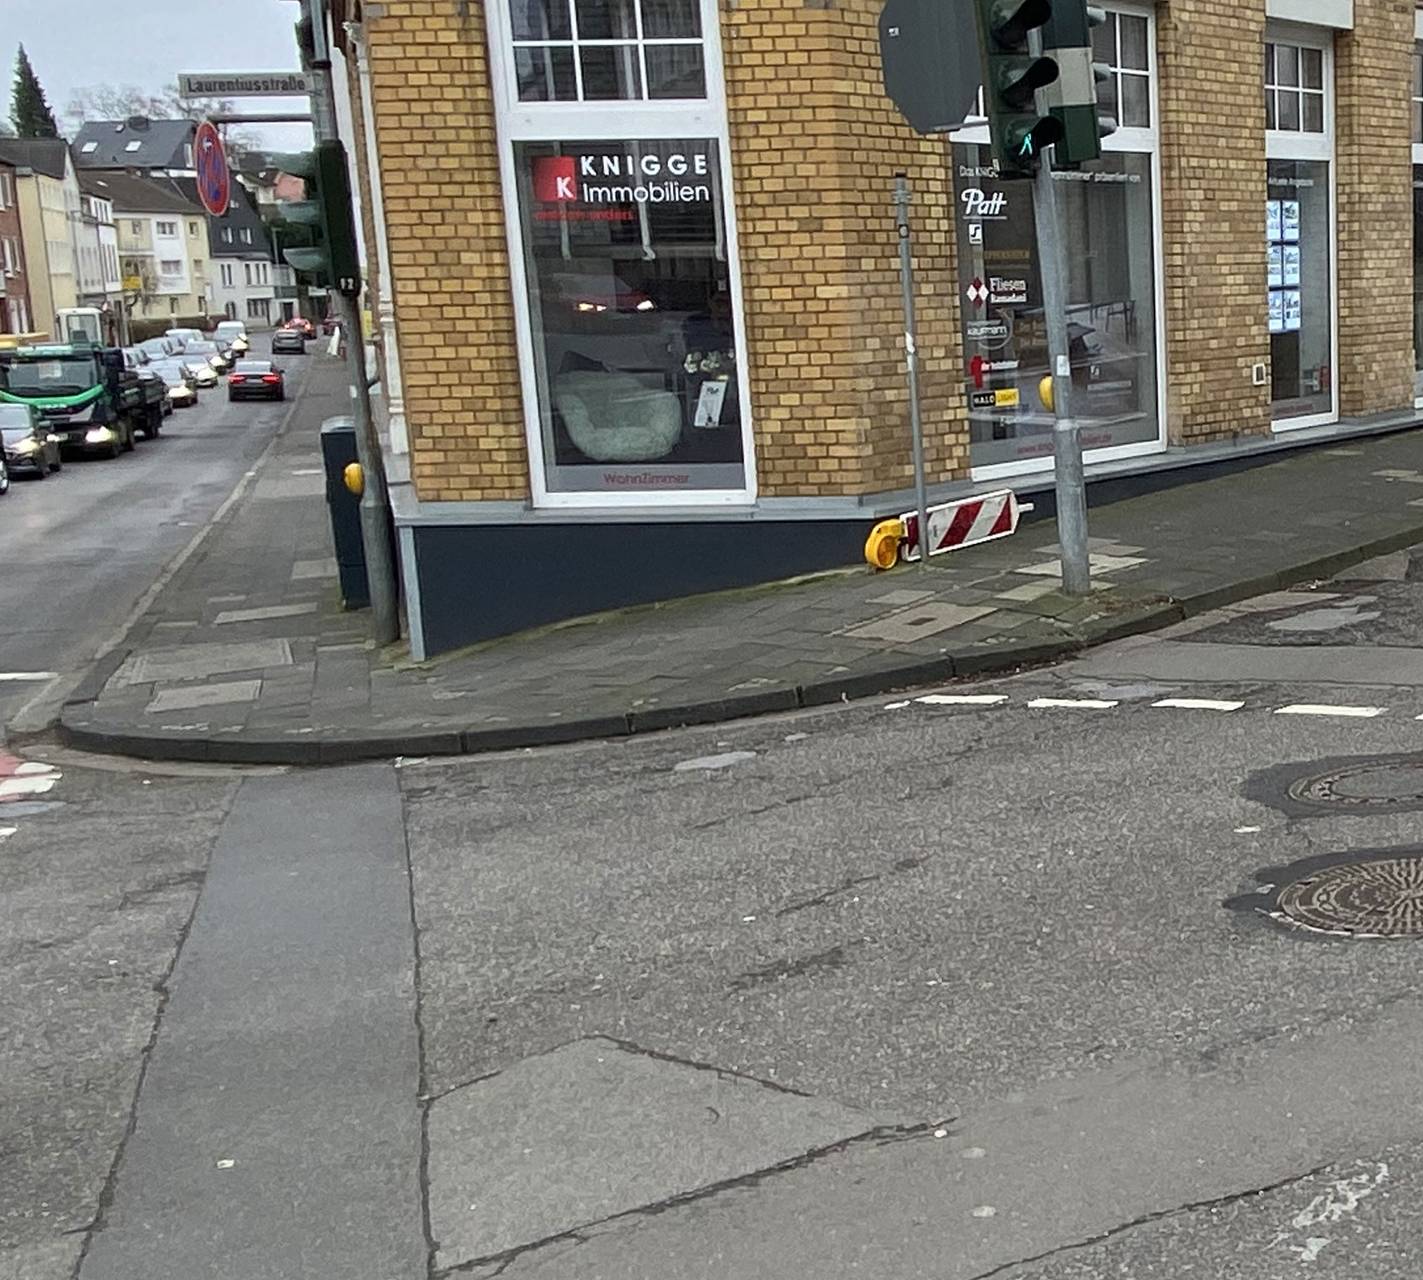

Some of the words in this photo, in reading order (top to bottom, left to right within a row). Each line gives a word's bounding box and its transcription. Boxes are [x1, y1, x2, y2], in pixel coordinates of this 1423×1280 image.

[187, 77, 305, 92] Laurentiusstraße
[580, 155, 708, 176] KNIGGE
[556, 176, 575, 199] K
[583, 182, 710, 203] Immobilien
[961, 188, 1007, 215] Patt
